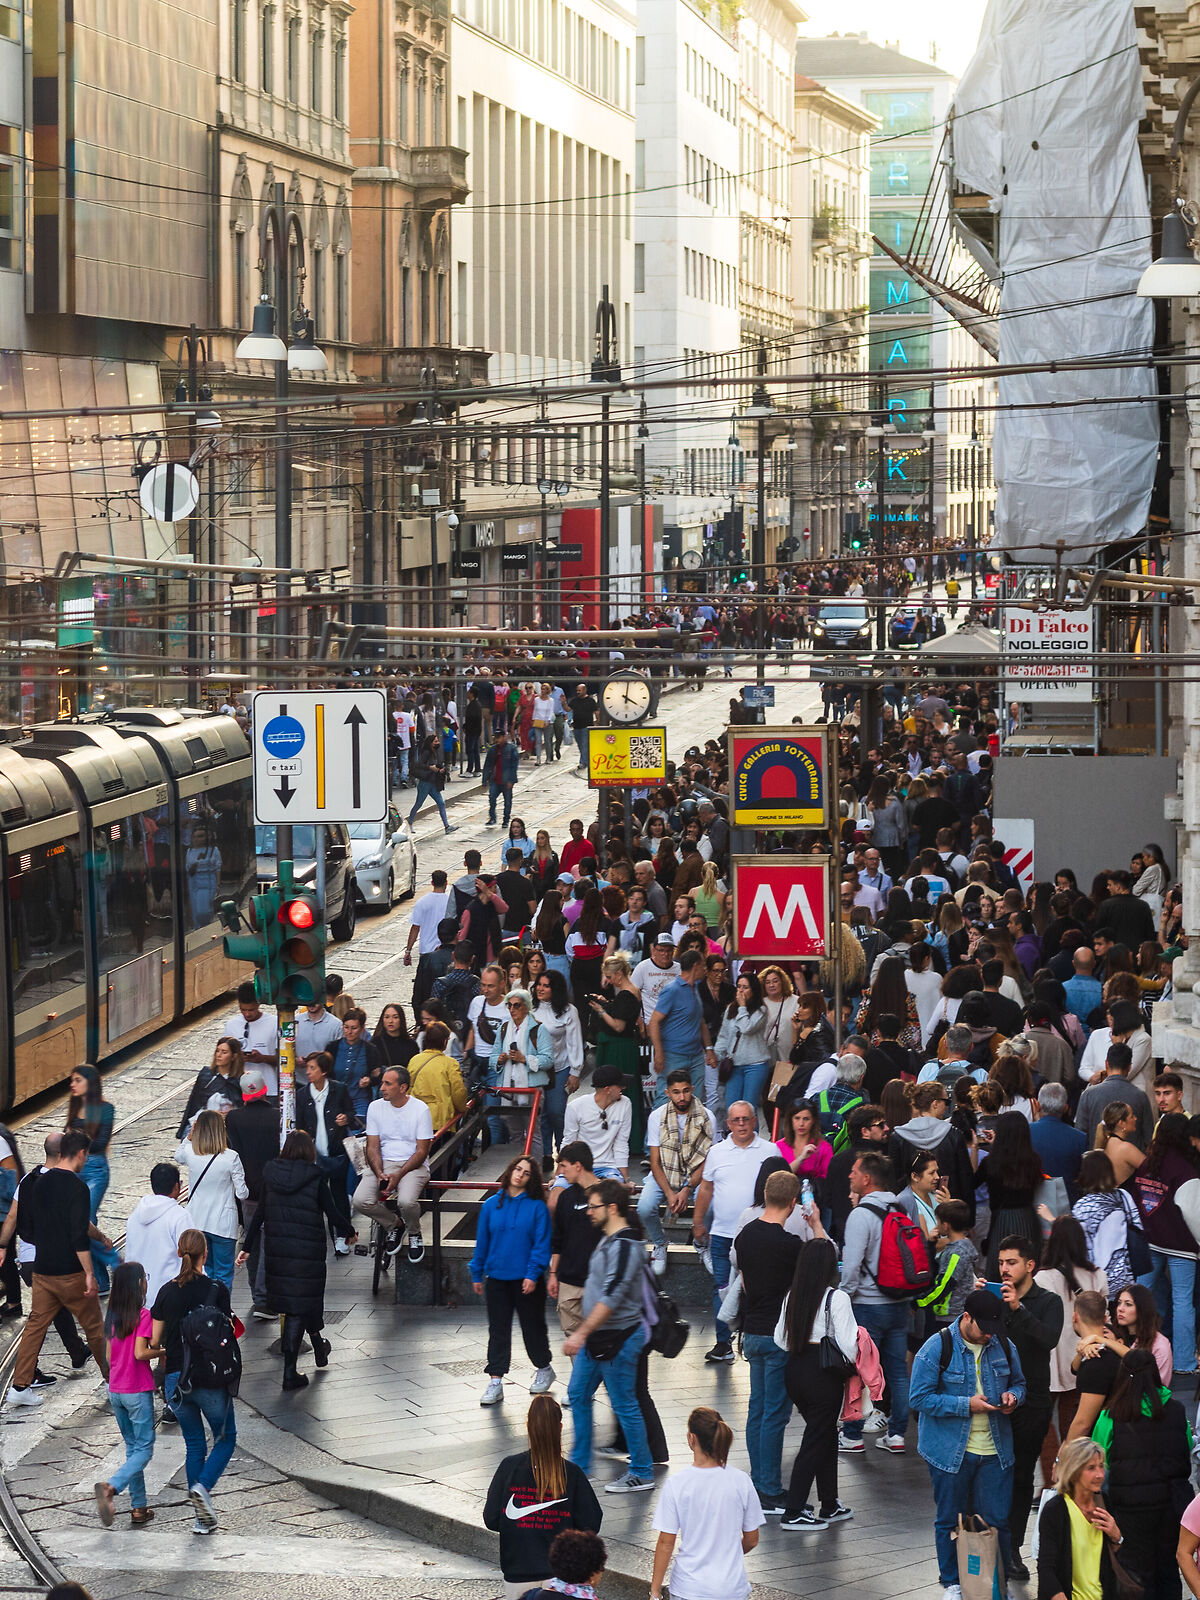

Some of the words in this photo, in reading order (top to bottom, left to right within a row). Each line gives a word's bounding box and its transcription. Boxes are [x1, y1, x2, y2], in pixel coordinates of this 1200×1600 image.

[886, 102, 910, 481] PRIMARK
[868, 513, 920, 522] PIMARK
[1009, 618, 1031, 633] Di
[1038, 618, 1089, 633] Falco
[1008, 640, 1089, 650] NOLEGGIO
[1020, 682, 1059, 690] OPERA
[280, 763, 297, 771] taxi
[743, 743, 781, 770] GALLERIA
[784, 745, 819, 800] SOTTERRANEA
[738, 772, 749, 802] CIVICA
[742, 884, 820, 939] M
